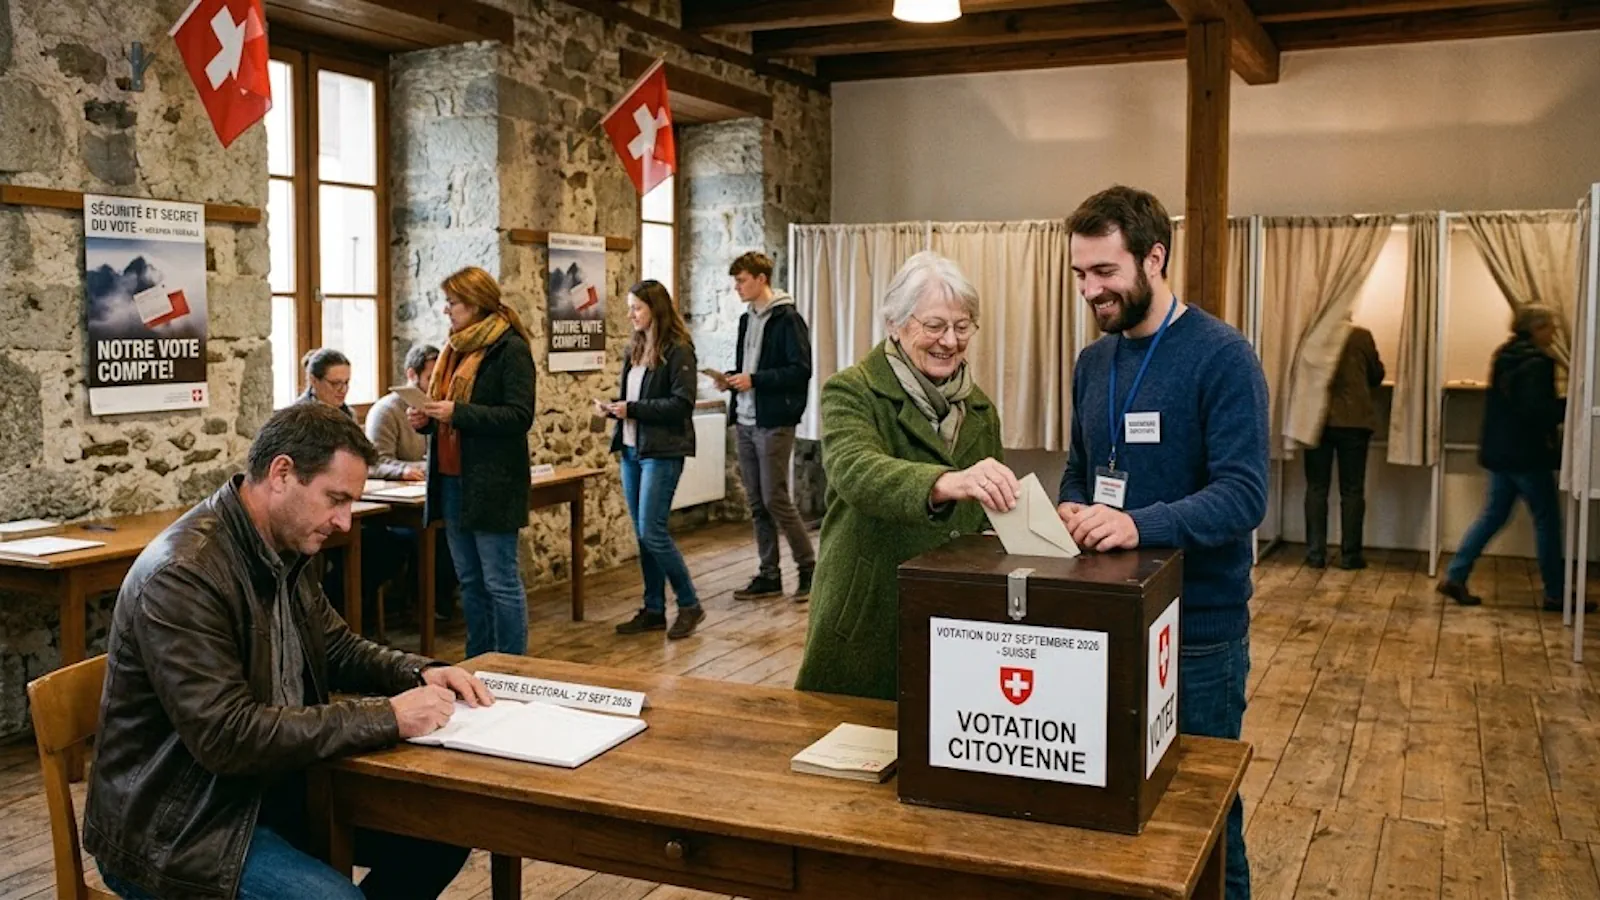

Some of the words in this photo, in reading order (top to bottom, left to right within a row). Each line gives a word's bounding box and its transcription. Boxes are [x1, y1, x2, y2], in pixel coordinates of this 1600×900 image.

[91, 201, 142, 218] SÉCURITÉ
[146, 207, 158, 219] ET
[161, 209, 199, 223] SECRET
[91, 219, 107, 231] DU
[111, 221, 137, 233] VOTE
[97, 339, 155, 360] NOTRE
[158, 338, 200, 358] VOTE
[97, 359, 174, 382] COMPTE!
[936, 626, 984, 641] VOTATION
[986, 631, 999, 642] DU
[1001, 632, 1012, 644] 27
[1015, 634, 1075, 650] SEPTEMBRE
[1077, 638, 1100, 651] 2026
[1001, 646, 1037, 659] SUISSE
[576, 690, 588, 702] 27
[588, 692, 611, 705] SEPT
[957, 710, 1077, 745] VOTATION
[1149, 692, 1175, 754] VOTEZ
[948, 737, 1087, 774] CITOYENNE
